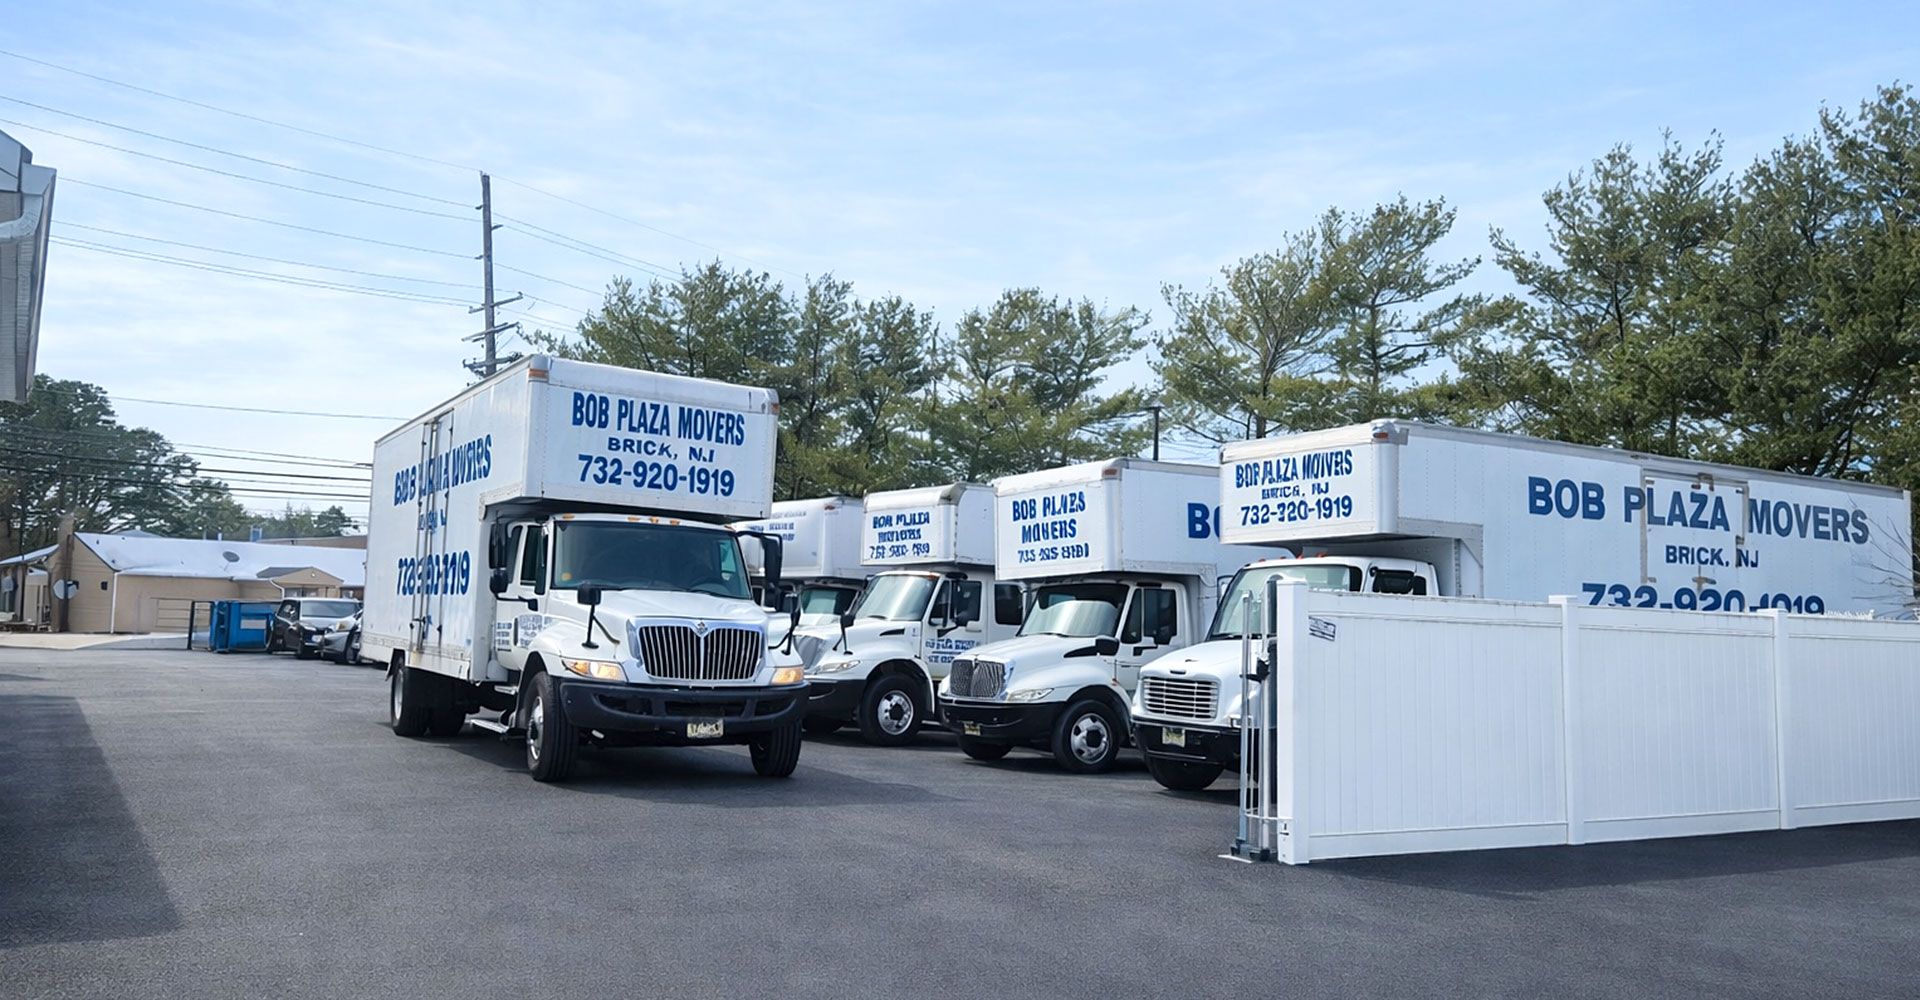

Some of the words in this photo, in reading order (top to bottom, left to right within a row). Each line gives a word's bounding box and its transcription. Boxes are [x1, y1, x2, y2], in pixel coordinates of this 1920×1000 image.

[572, 391, 609, 428] BOB
[617, 398, 670, 437] PLAZA
[677, 406, 745, 446] MOVERS
[607, 437, 678, 460] BRICK,
[578, 454, 735, 497] 732-920-1919
[1012, 498, 1037, 522] BOB
[1187, 502, 1220, 539] B
[1527, 475, 1606, 521] BOB
[1624, 485, 1730, 532] PLAZA
[1748, 498, 1870, 545] MOVERS
[1665, 544, 1730, 567] BRICK,
[1735, 547, 1759, 568] NJ
